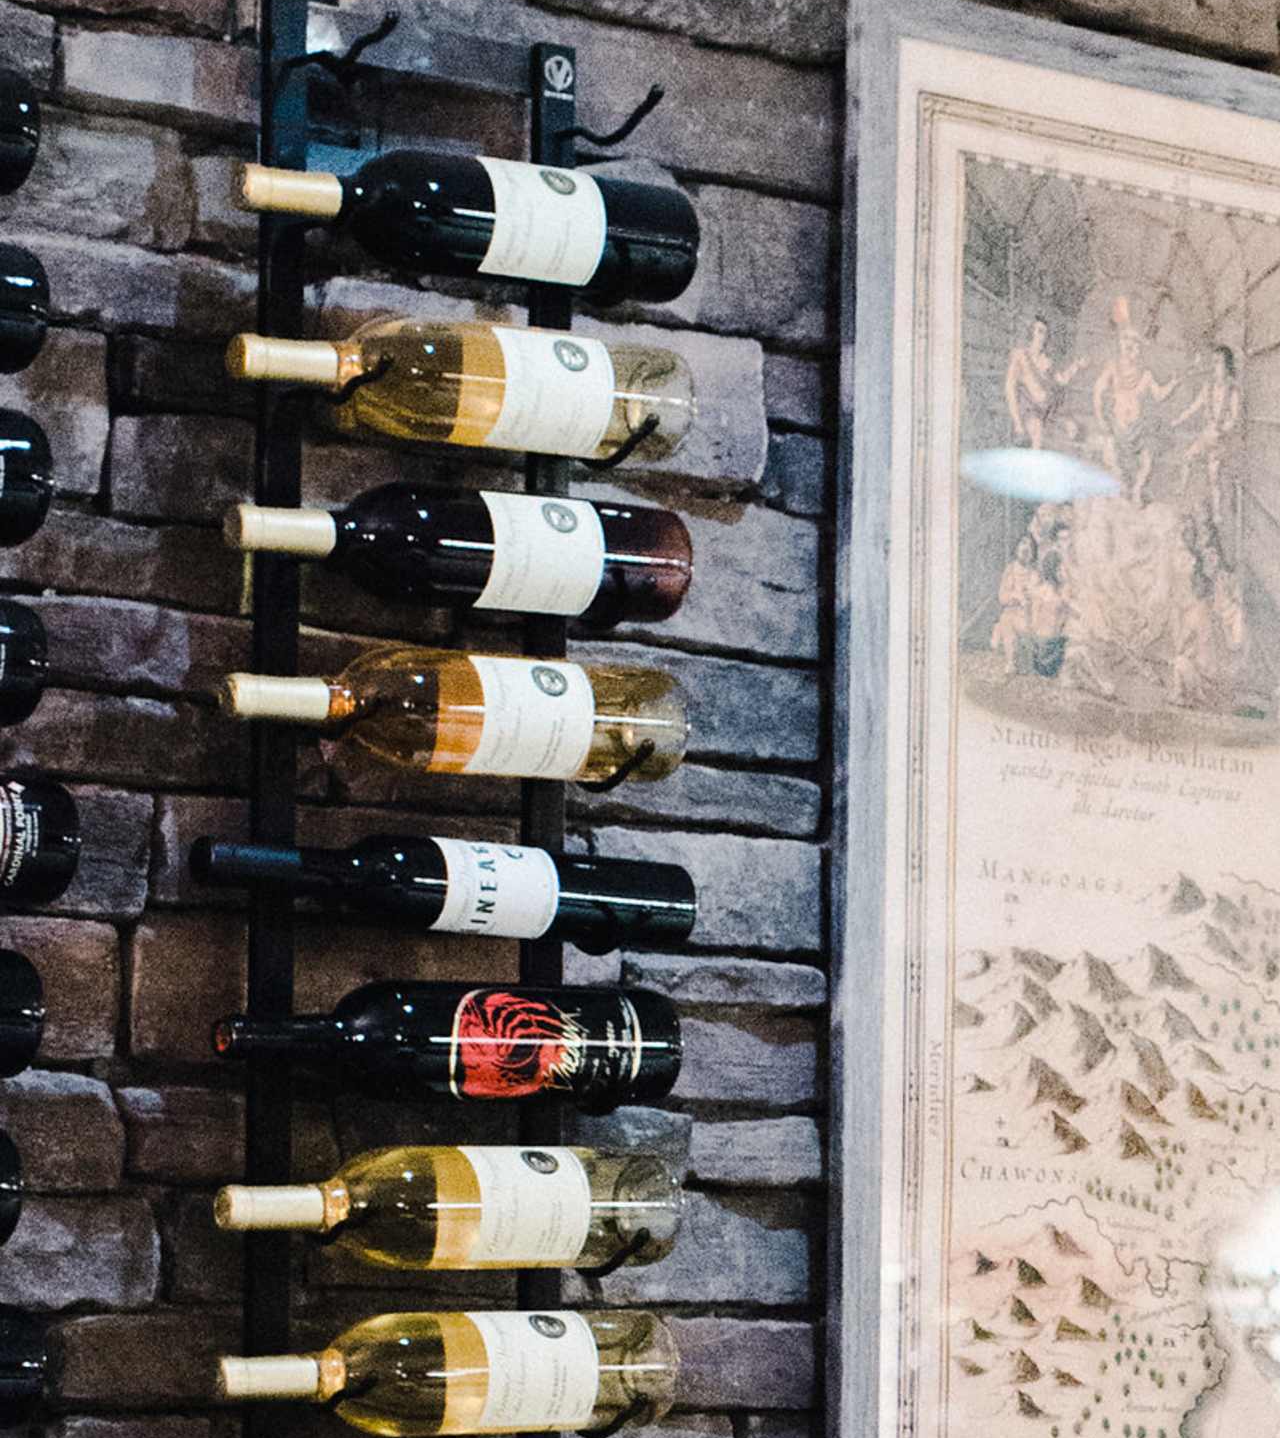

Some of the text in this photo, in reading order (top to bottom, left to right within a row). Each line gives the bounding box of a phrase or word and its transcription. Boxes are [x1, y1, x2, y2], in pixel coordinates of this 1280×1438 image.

[990, 723, 1256, 776] Status Regis Powhatan
